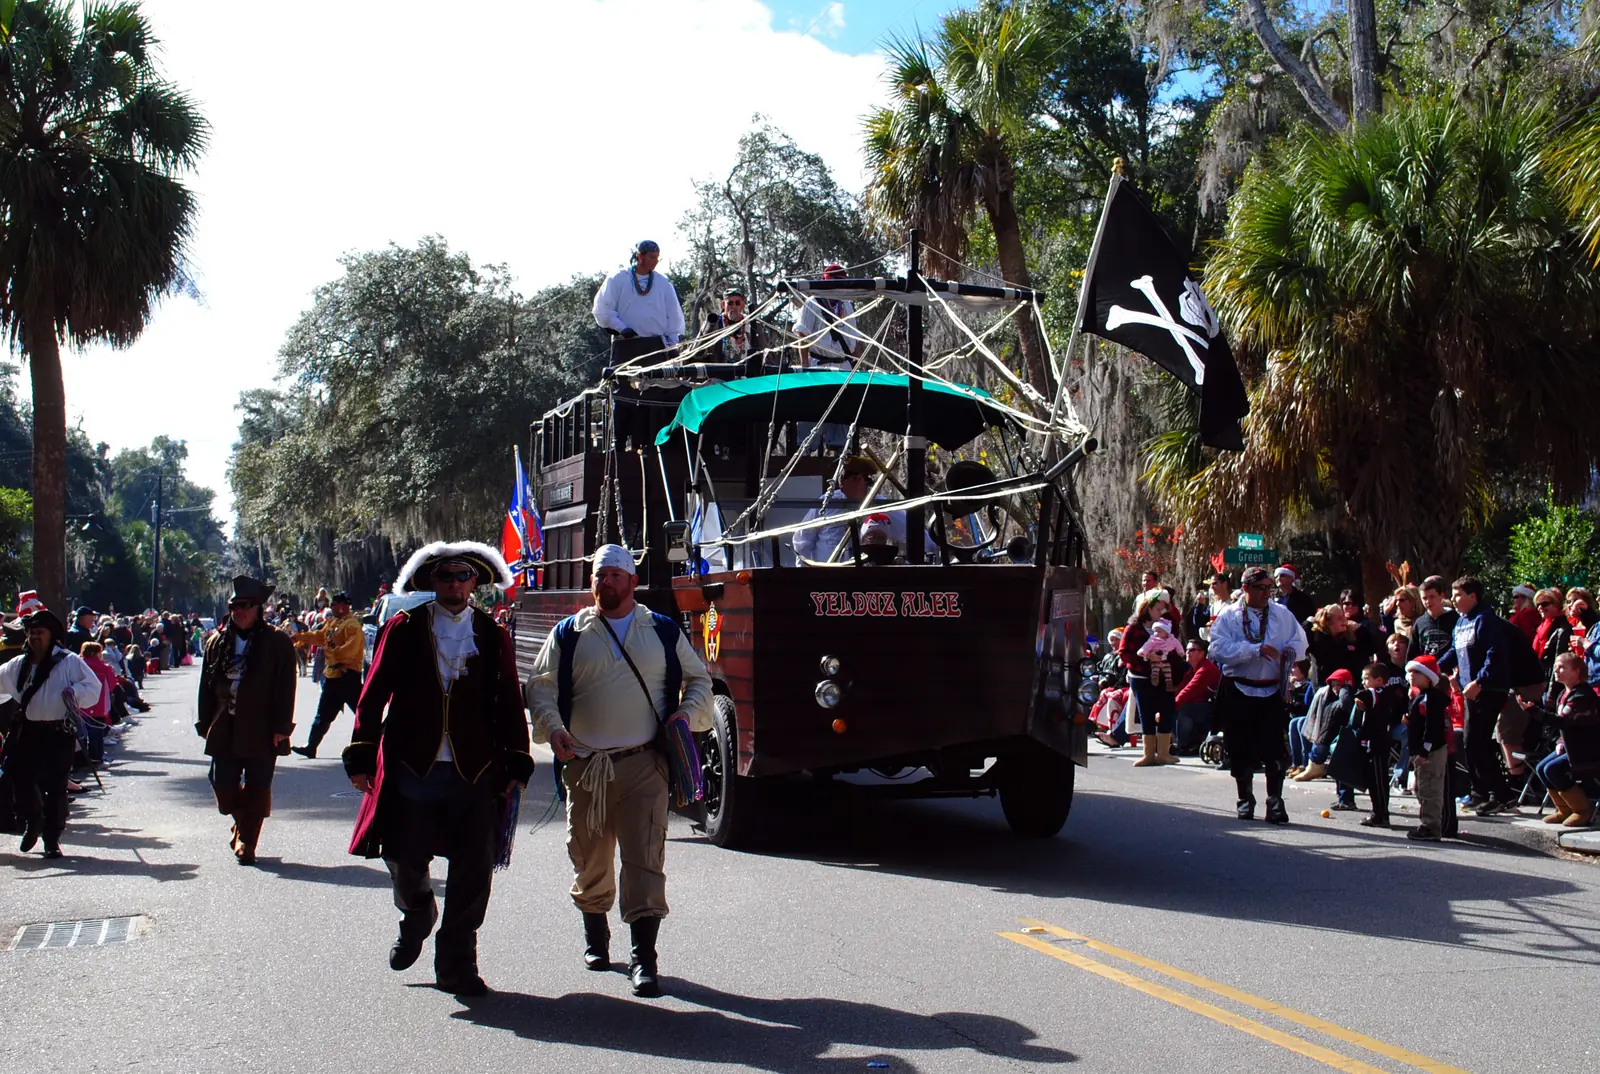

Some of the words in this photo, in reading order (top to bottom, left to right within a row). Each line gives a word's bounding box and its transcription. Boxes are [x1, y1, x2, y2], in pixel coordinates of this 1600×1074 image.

[1238, 551, 1264, 562] Green
[810, 592, 897, 617] YELDUZ
[901, 592, 961, 618] ALEE
